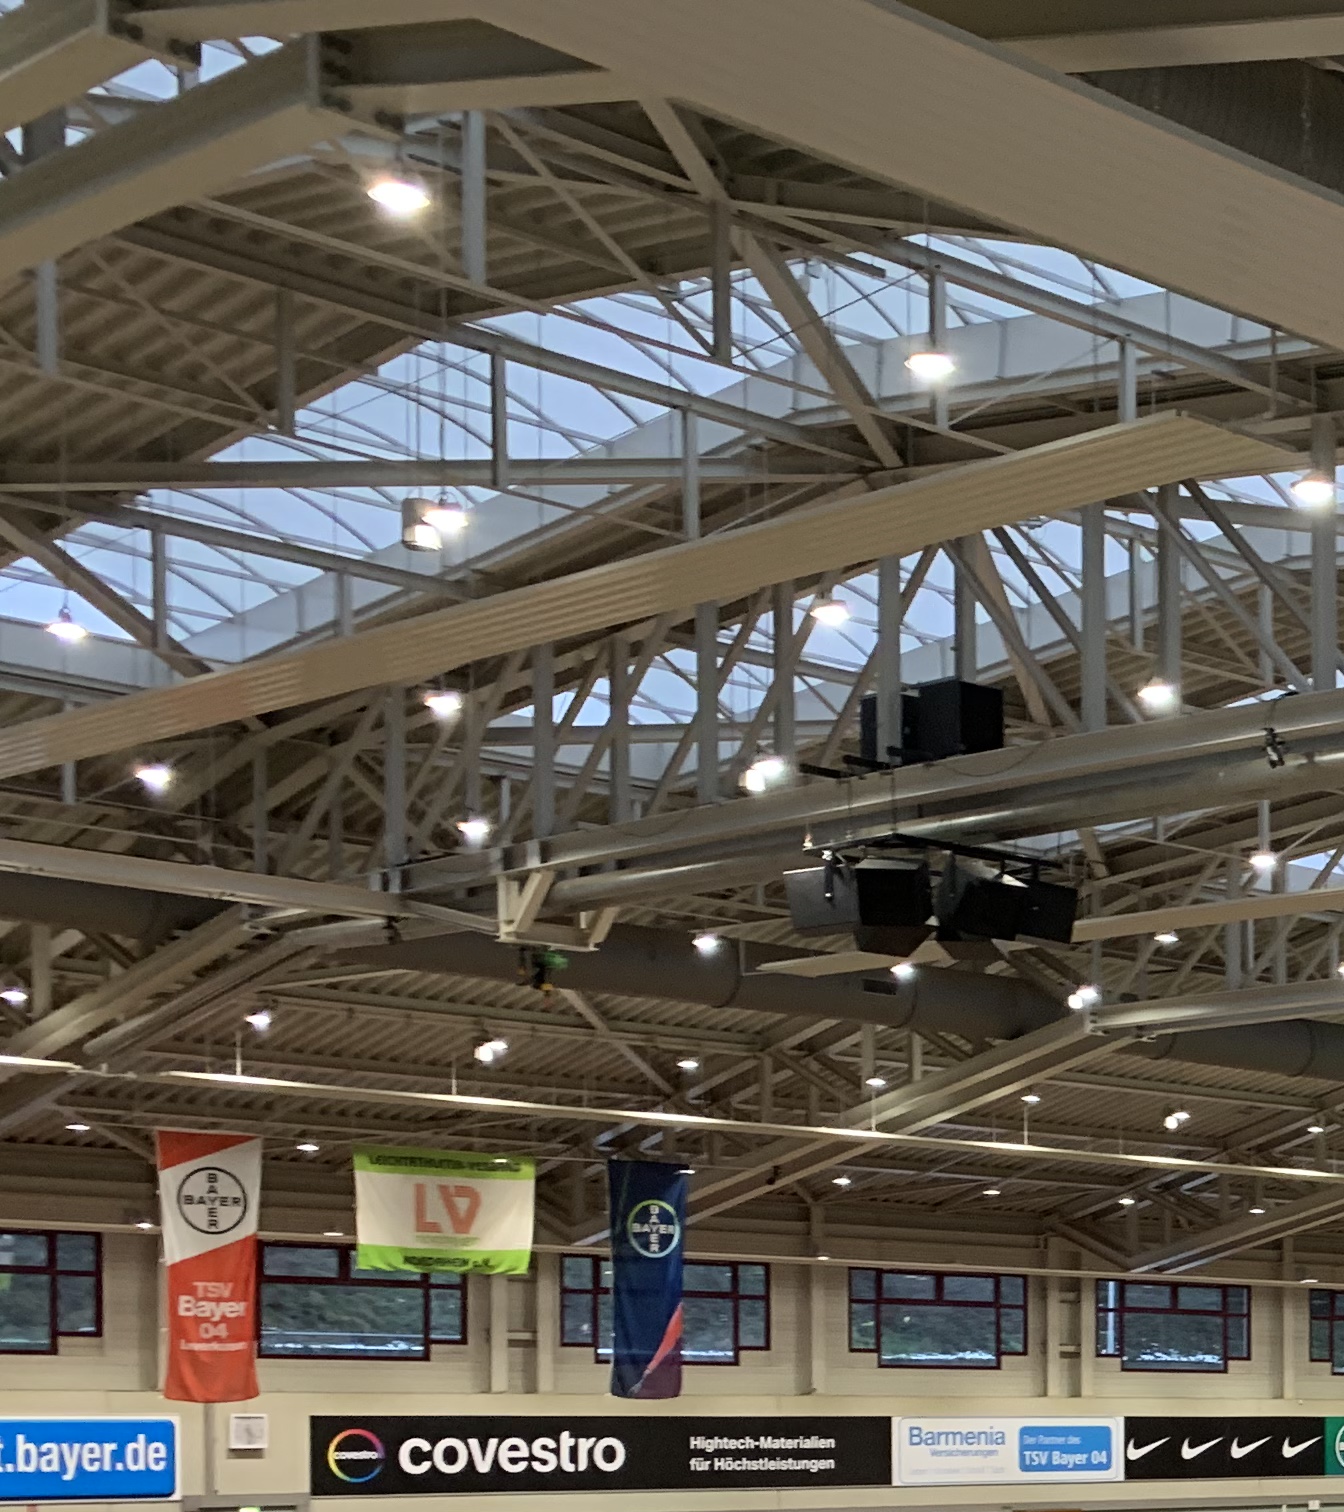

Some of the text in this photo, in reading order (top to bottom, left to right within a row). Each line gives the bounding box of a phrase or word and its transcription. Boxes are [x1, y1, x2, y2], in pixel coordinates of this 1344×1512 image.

[183, 1194, 242, 1206] BAYER
[206, 1172, 219, 1230] BAYER
[192, 1281, 234, 1298] TSV
[177, 1295, 248, 1321] Bayer
[199, 1322, 229, 1340] 04
[689, 1436, 836, 1452] Hightech-Materialien
[908, 1425, 1006, 1446] Barmenia
[397, 1430, 626, 1475] covestro
[1023, 1449, 1108, 1469] TSV Bayer 04
[689, 1456, 836, 1473] für Höchstleistungen
